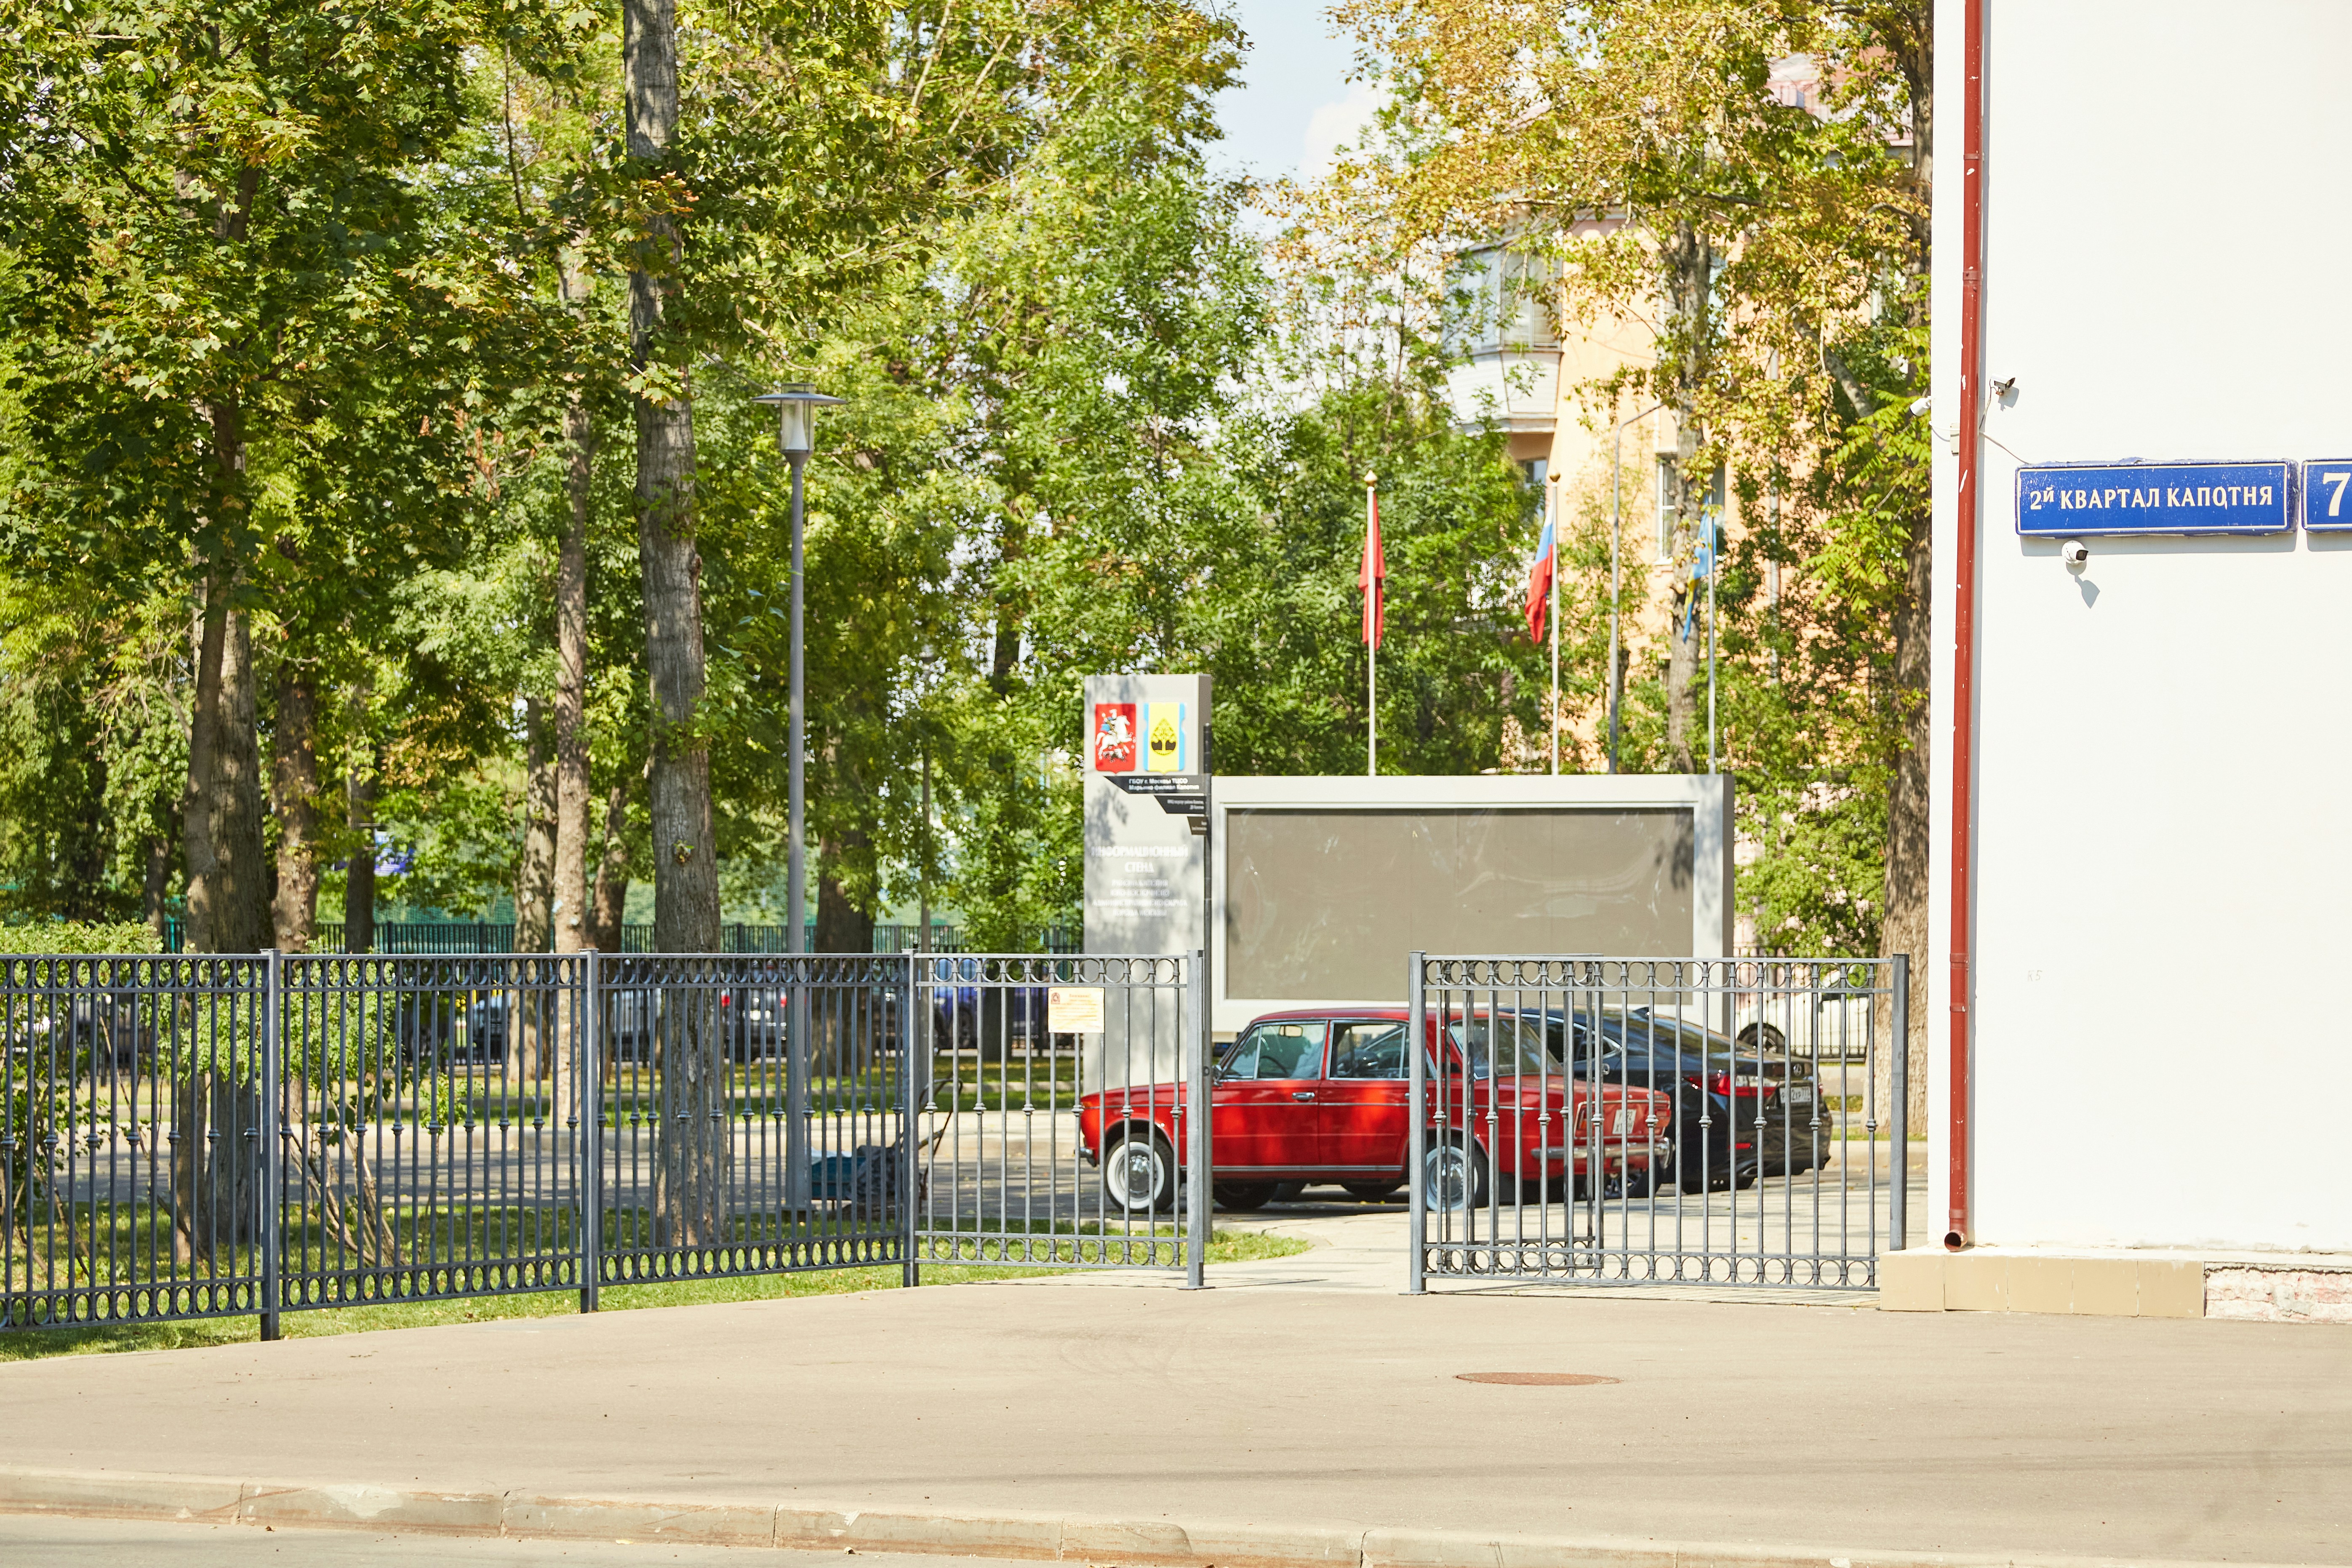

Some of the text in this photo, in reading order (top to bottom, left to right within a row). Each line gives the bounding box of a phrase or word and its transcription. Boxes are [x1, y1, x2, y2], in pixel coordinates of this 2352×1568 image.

[2061, 488, 2160, 509] КВАРТАЛ
[2168, 486, 2272, 507] КАПОТНЯ
[2323, 472, 2351, 517] 7
[1091, 844, 1188, 857] ИНФОРМАЦИОННЫЙ
[1125, 862, 1155, 873] СТЕНД
